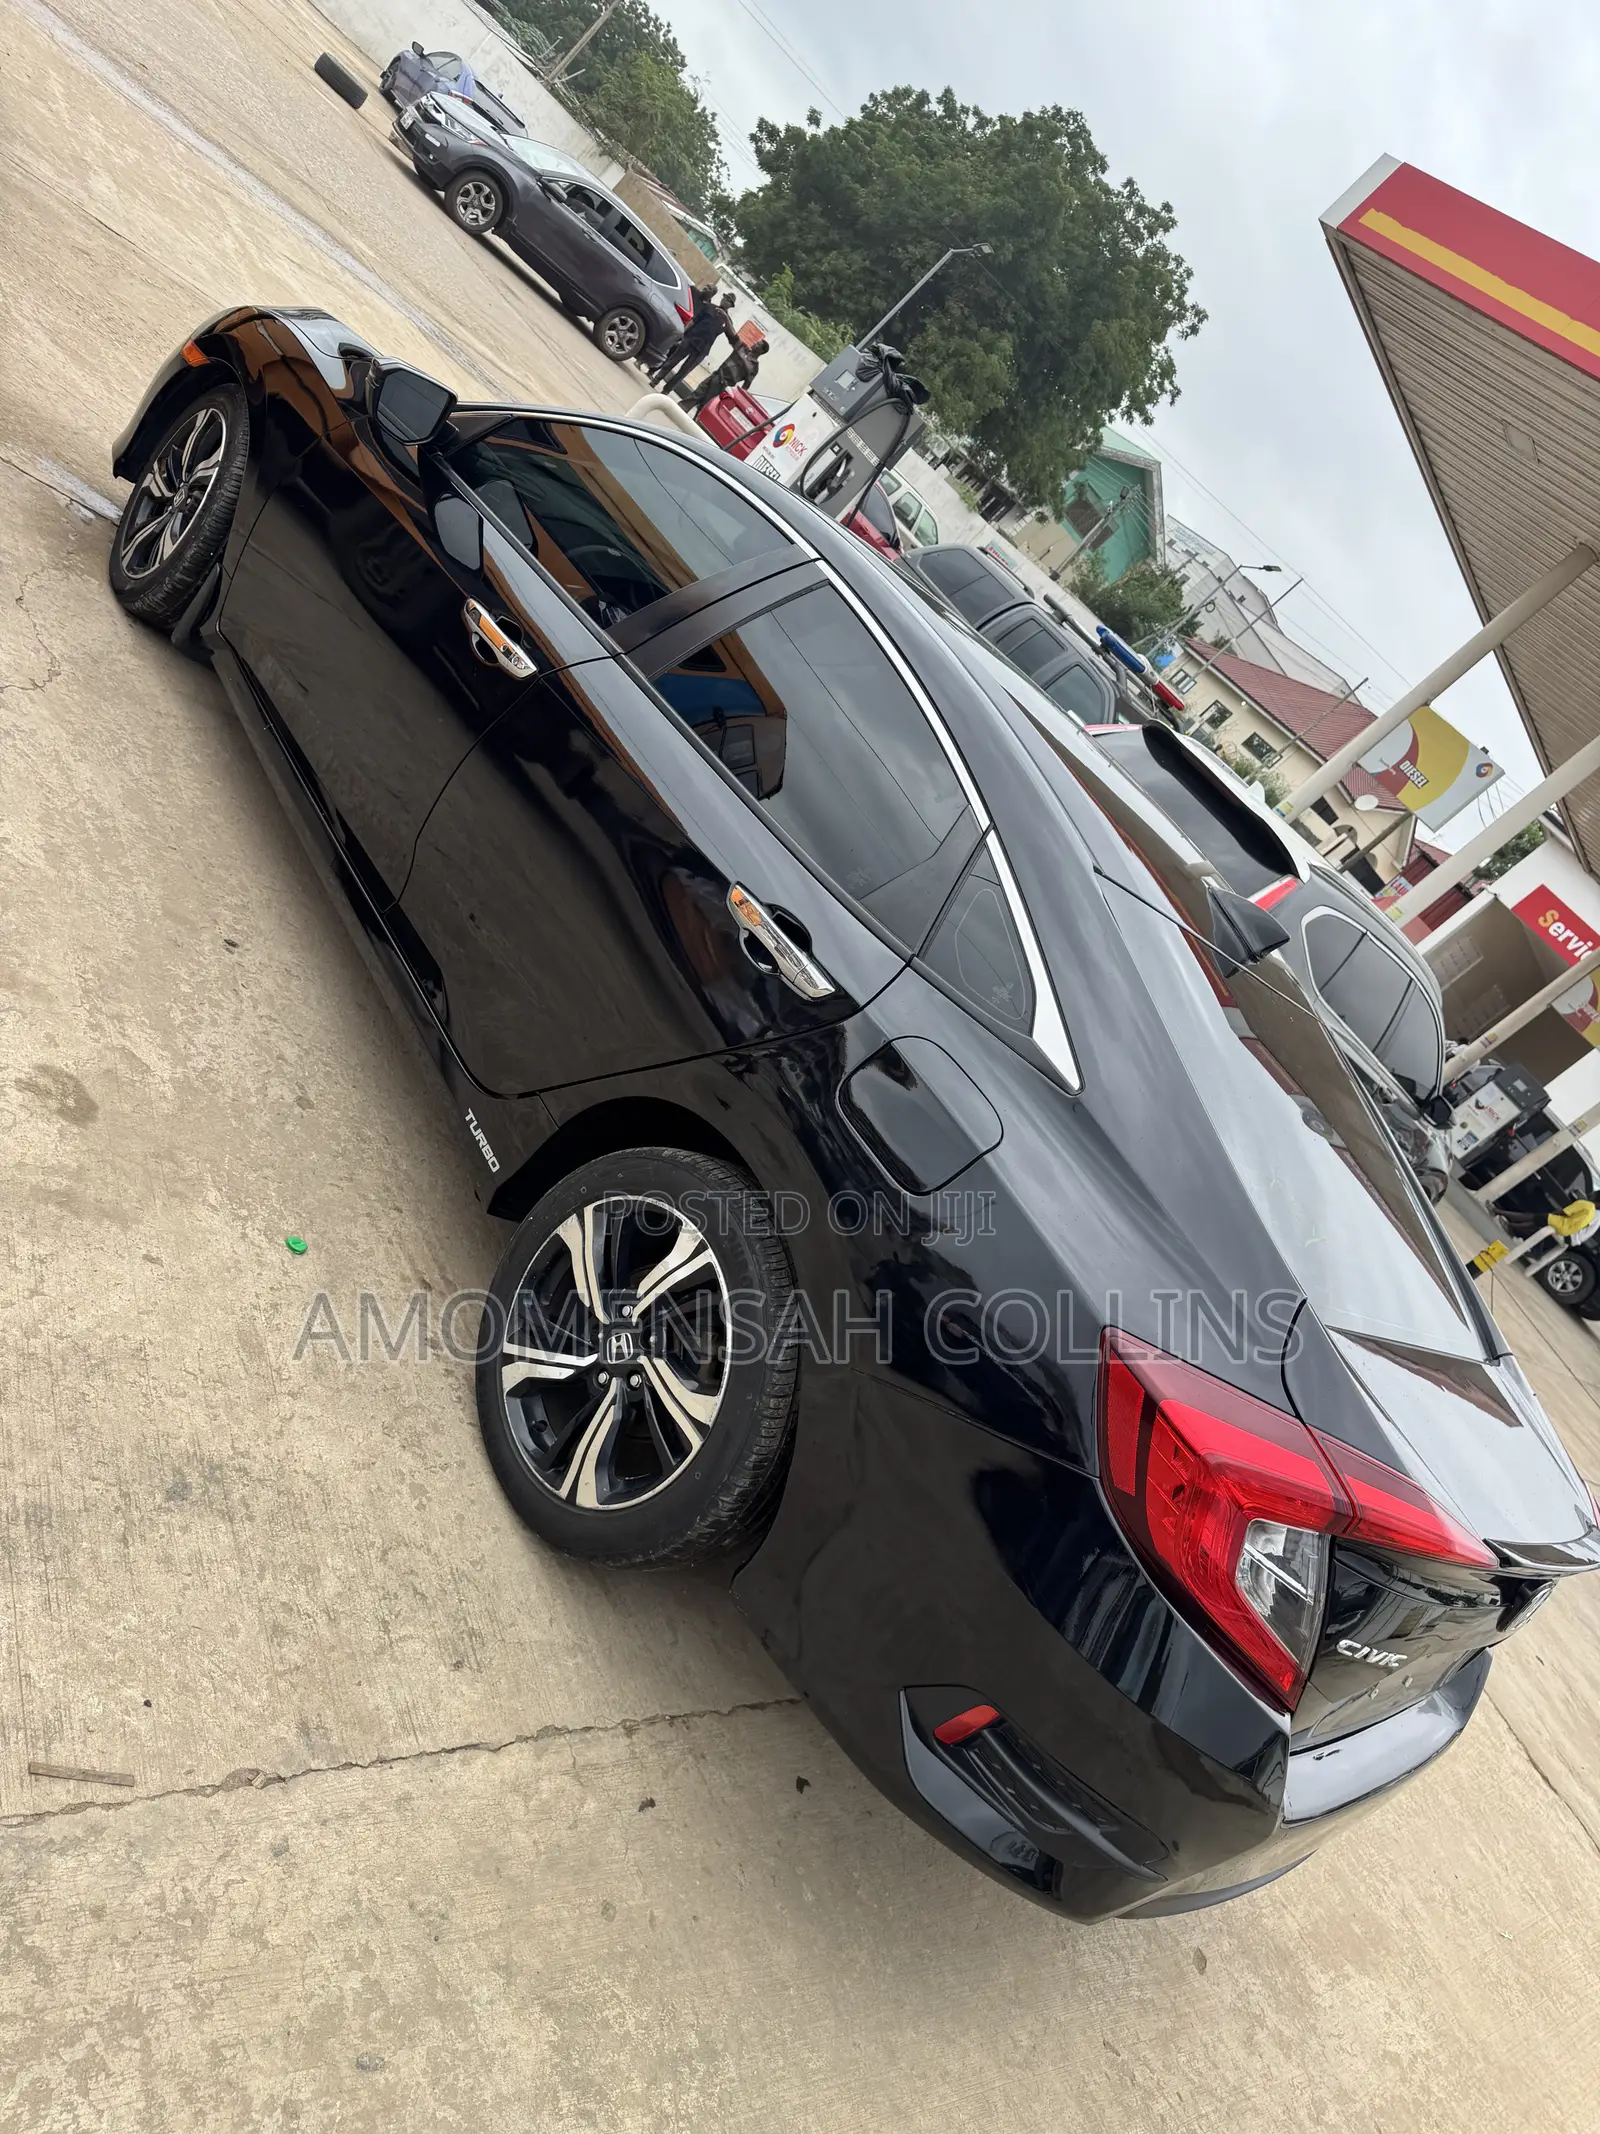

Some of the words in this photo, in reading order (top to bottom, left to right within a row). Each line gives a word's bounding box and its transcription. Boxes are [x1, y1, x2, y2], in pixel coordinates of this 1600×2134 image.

[789, 437, 807, 456] NICK
[1398, 760, 1429, 788] DIESEL
[465, 1107, 500, 1173] TURBO
[1336, 1639, 1408, 1667] CIVIC
